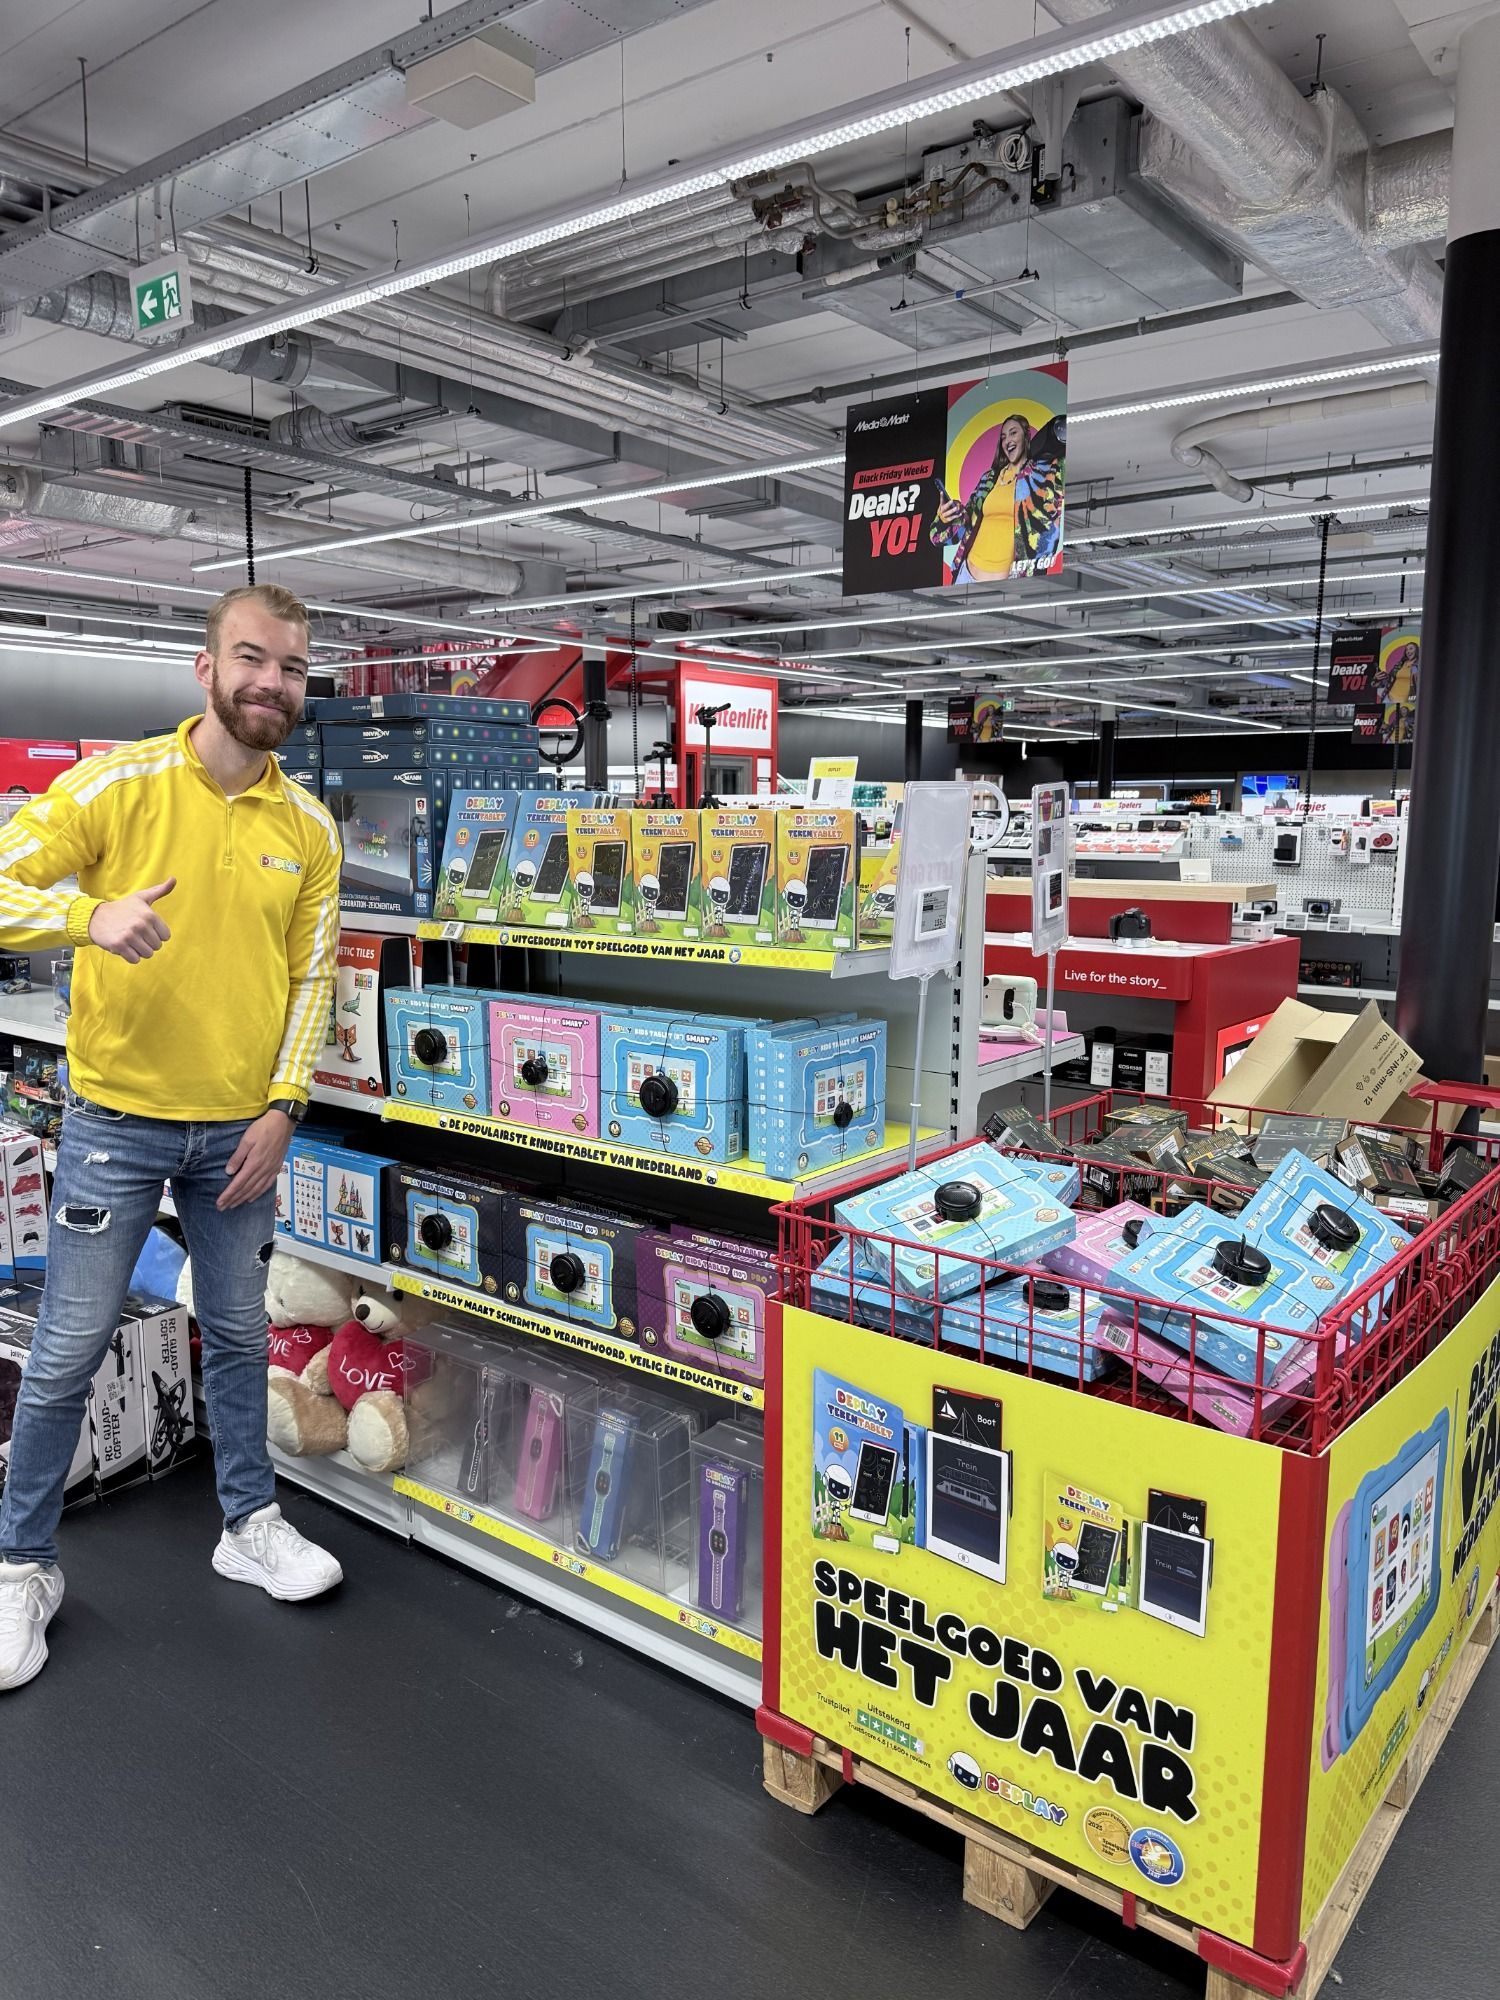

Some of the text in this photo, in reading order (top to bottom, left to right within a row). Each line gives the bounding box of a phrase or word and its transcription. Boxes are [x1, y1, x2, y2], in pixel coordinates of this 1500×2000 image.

[858, 464, 929, 484] Black Friday Weeks
[848, 484, 921, 520] Deals?
[869, 513, 923, 558] YO!
[1011, 557, 1056, 572] LET'S GO!
[1331, 664, 1367, 676] Deals?
[1341, 675, 1367, 691] YO!
[688, 703, 768, 730] Kntenlift
[1360, 725, 1377, 735] YO!
[466, 796, 504, 809] DEPLAY
[535, 798, 578, 811] DEPLAY
[457, 812, 506, 822] TEKENTABLET
[580, 814, 616, 825] DEPLAY
[647, 814, 683, 826] DEPLAY
[717, 814, 758, 827] DEPLAY
[795, 814, 839, 827] DEPLAY
[459, 831, 467, 839] 11
[527, 833, 536, 841] 11
[575, 827, 621, 836] TEKENTABLET
[640, 828, 689, 837] TEKENTABLET
[711, 829, 764, 839] TEKENTABLET
[788, 829, 843, 839] TEKENTABLET
[356, 947, 375, 960] TILES
[511, 934, 725, 959] UITGEROEPEN TOT SPEELGOED VAN HET JAAR
[1064, 969, 1087, 981] Live
[1089, 970, 1106, 984] for
[1108, 972, 1127, 985] the
[562, 1018, 582, 1028] SMART
[649, 1030, 673, 1039] TABLET
[685, 1033, 710, 1044] SMART
[859, 1031, 877, 1042] SMART
[1363, 1048, 1408, 1106] FF-INS-mini 12
[448, 1118, 703, 1181] DE POPULAIRSTE KINDERTABLET VAN NEDERLAND
[519, 1207, 544, 1221] DEPLAY
[545, 1216, 560, 1225] KIDS
[559, 1217, 584, 1231] TABLET
[601, 1228, 616, 1239] PRO
[692, 1234, 767, 1259] DEPLAY KIDS TABLET
[656, 1247, 684, 1262] DEPLAY
[685, 1255, 703, 1268] KIDS
[702, 1258, 730, 1275] TABLET
[750, 1272, 768, 1284] PRO
[159, 1319, 169, 1364] COPTER
[168, 1317, 178, 1378] RC QUAD-
[432, 1289, 739, 1396] DEPLAY MAAKT SCHERMTIJD VERANTWOORD, VEILIG ÉN EDUCATIEF
[340, 1355, 396, 1392] LOVE
[1468, 1346, 1489, 1414] DE
[836, 1388, 888, 1422] DEPLAY
[826, 1402, 894, 1440] TEKENTABLET
[977, 1414, 997, 1427] Boot
[113, 1413, 122, 1459] COPTER
[833, 1431, 845, 1443] 11
[104, 1446, 113, 1462] RC
[957, 1458, 978, 1472] Trein
[1461, 1401, 1500, 1529] VA
[705, 1468, 736, 1486] DEPLAY
[1066, 1484, 1111, 1511] DEPLAY
[445, 1502, 474, 1523] DEPLAY
[1058, 1495, 1116, 1524] TEKENTABLET
[1182, 1512, 1199, 1522] Boot
[552, 1551, 586, 1576] DEPLAY
[1154, 1558, 1172, 1570] Trein
[678, 1610, 718, 1638] DEPLAY
[813, 1559, 1195, 1753] SPEELGOED VAN
[815, 1600, 1200, 1824] HET JAAR
[816, 1691, 851, 1715] Trustpilot
[867, 1702, 911, 1730] Uitstekend
[848, 1721, 931, 1769] TrustScore reviews
[985, 1771, 1068, 1826] DEPLAY
[1088, 1819, 1103, 1831] 2025
